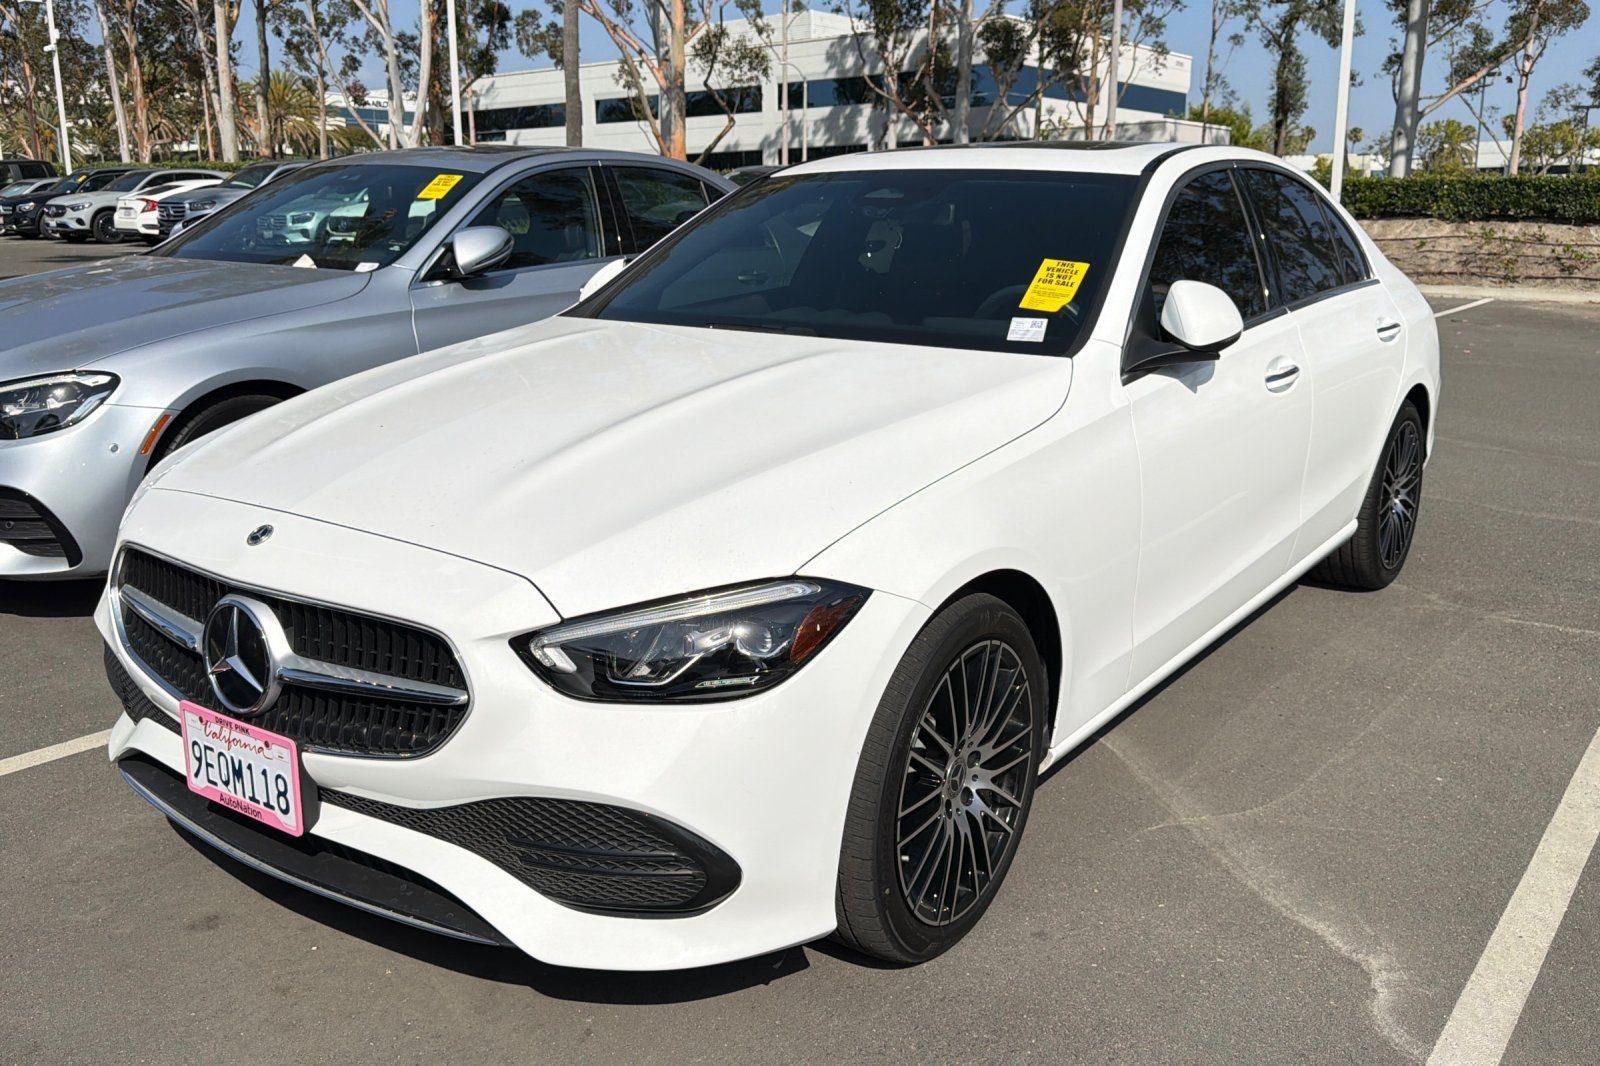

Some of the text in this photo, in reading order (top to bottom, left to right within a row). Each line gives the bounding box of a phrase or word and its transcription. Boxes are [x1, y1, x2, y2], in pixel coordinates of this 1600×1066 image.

[1046, 266, 1079, 275] VEHICLE
[215, 717, 250, 735] DRIVE PINK
[204, 720, 273, 760] California
[191, 740, 290, 815] 9EQM118
[220, 793, 262, 819] AutoNation
